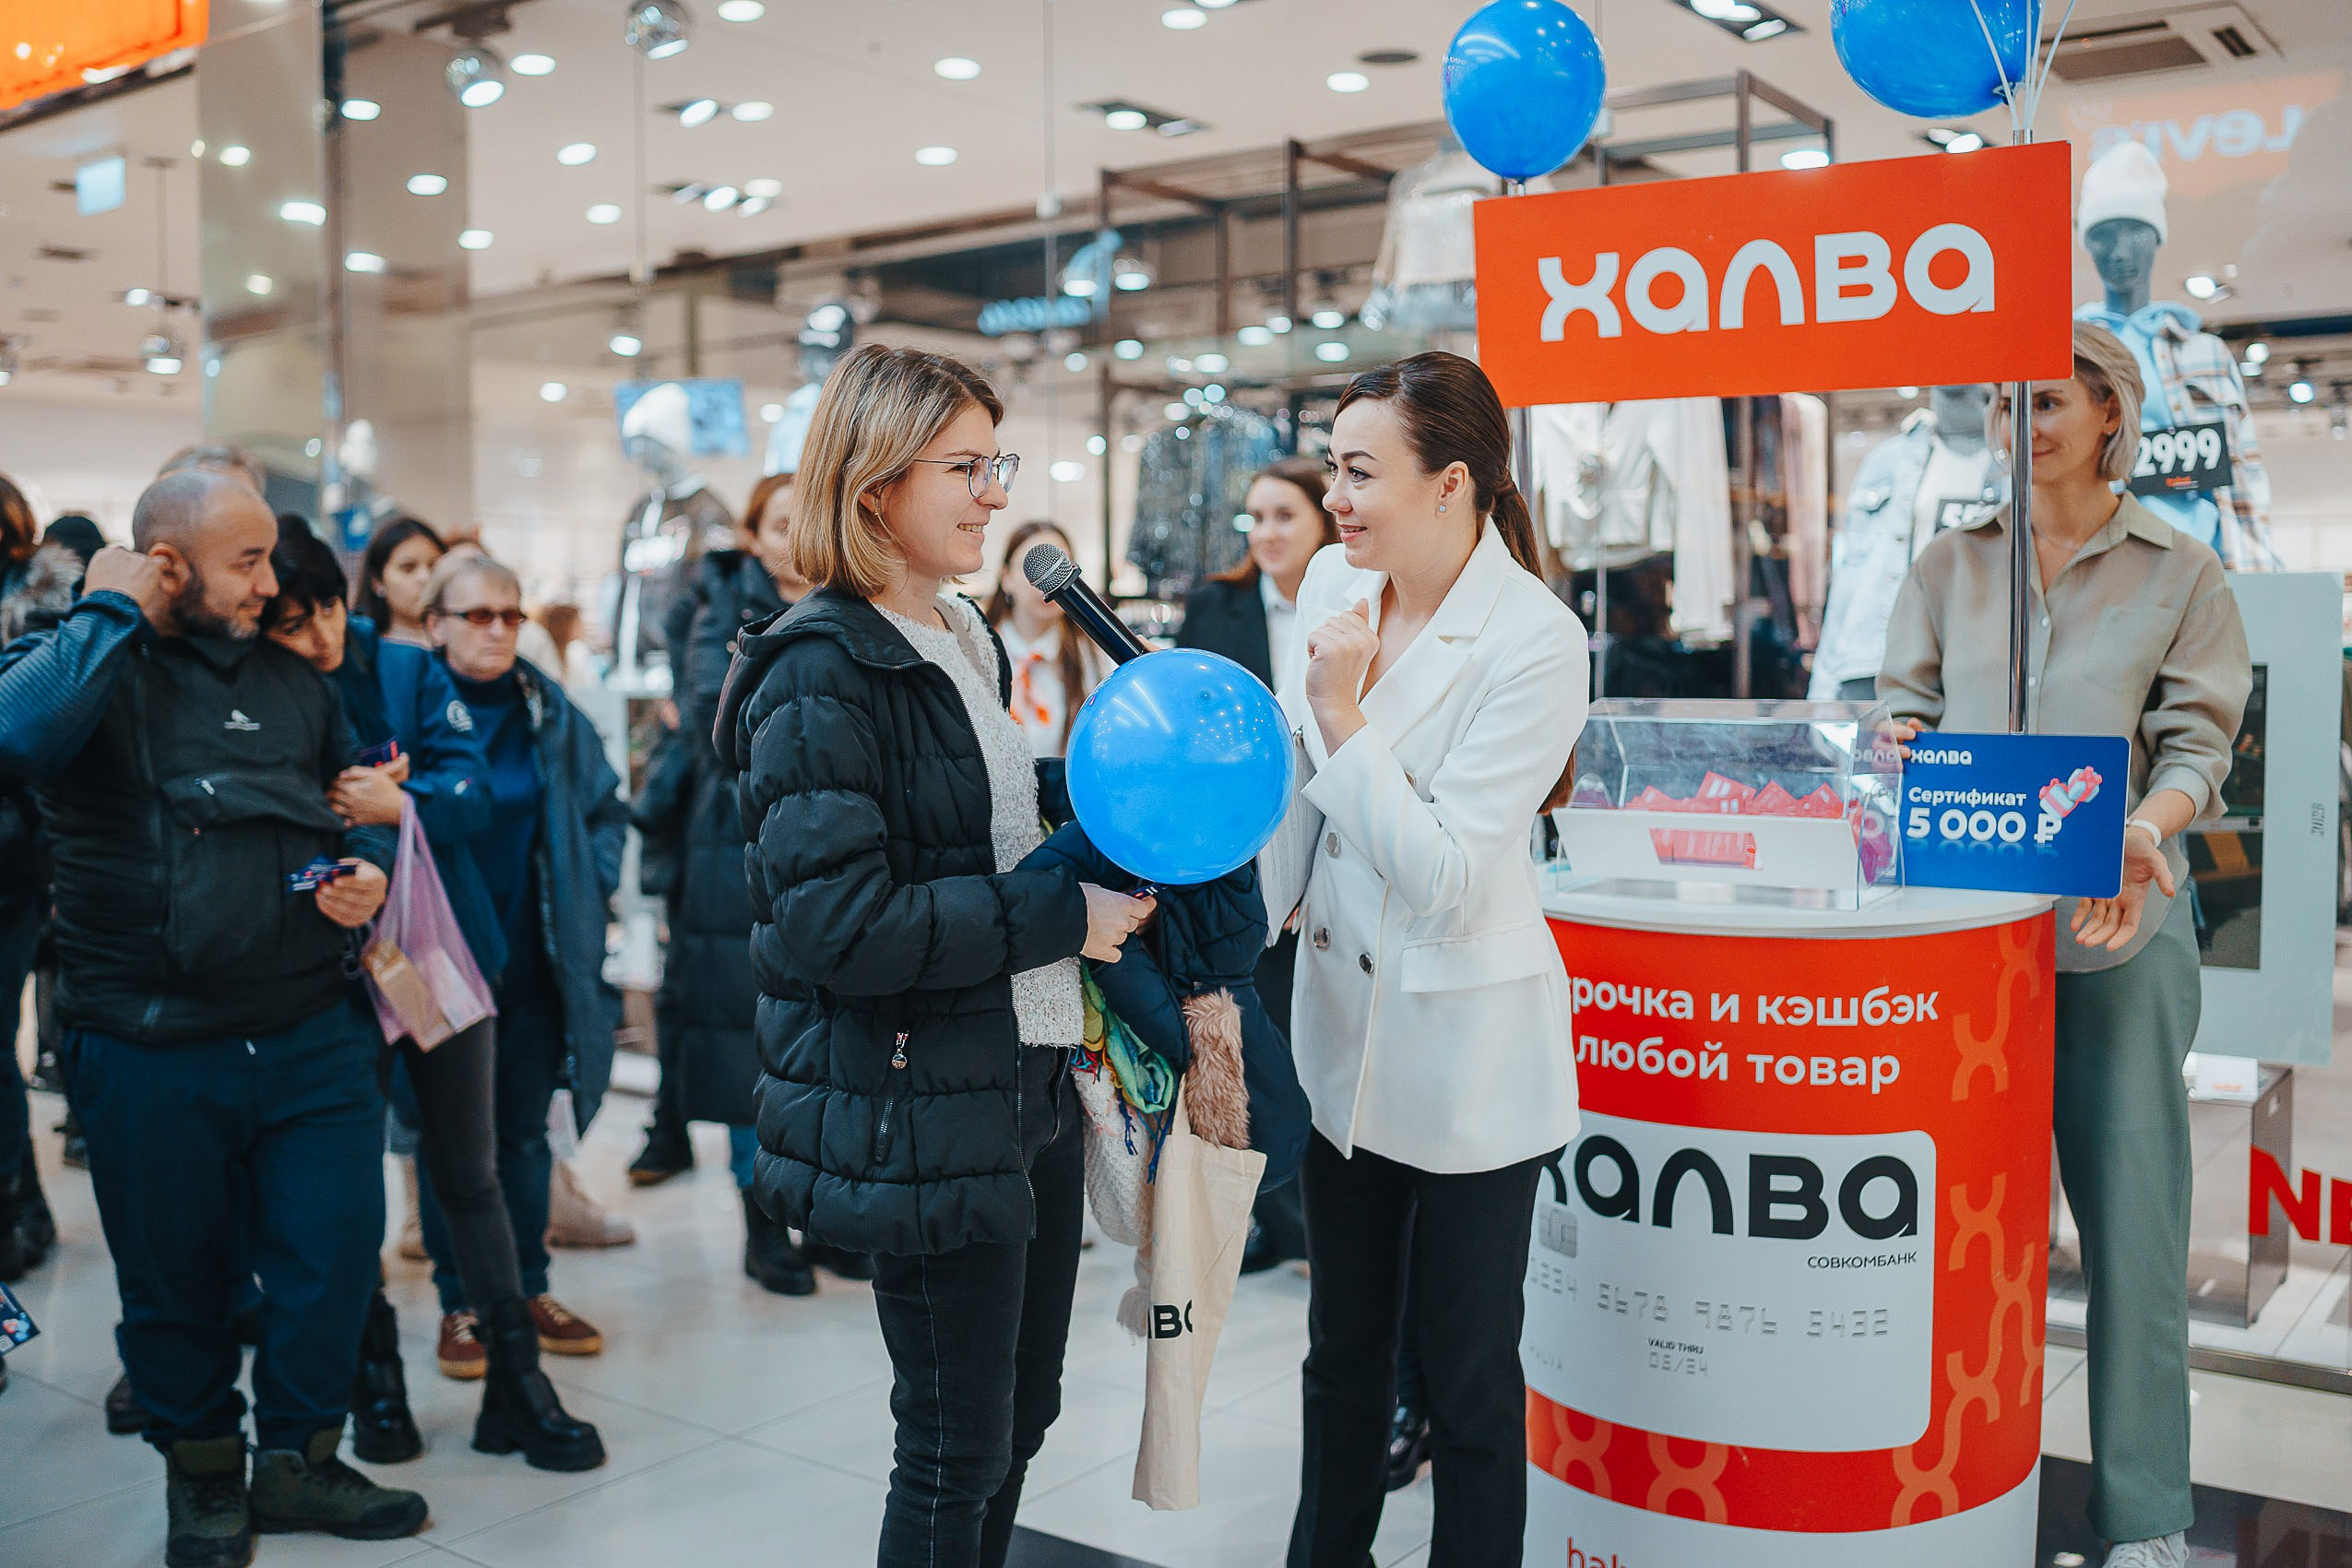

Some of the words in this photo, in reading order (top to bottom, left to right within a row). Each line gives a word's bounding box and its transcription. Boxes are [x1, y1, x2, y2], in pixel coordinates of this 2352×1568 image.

[2132, 428, 2222, 478] 2999
[1907, 787, 2027, 807] Сертификат
[1907, 807, 1931, 839] 5
[1939, 808, 2027, 843] 000
[1569, 976, 1694, 1020] рочка
[1709, 992, 1740, 1023] и
[1756, 985, 1939, 1027] кэшбэк
[1575, 1034, 1729, 1081] любой
[1746, 1052, 1901, 1095] товар
[1807, 1251, 1918, 1270] СОВКОМБАНК
[1597, 1282, 1669, 1324] 5678
[1694, 1301, 1778, 1336] 9876
[1647, 1337, 1676, 1350] VALID
[1677, 1342, 1705, 1355] THRU
